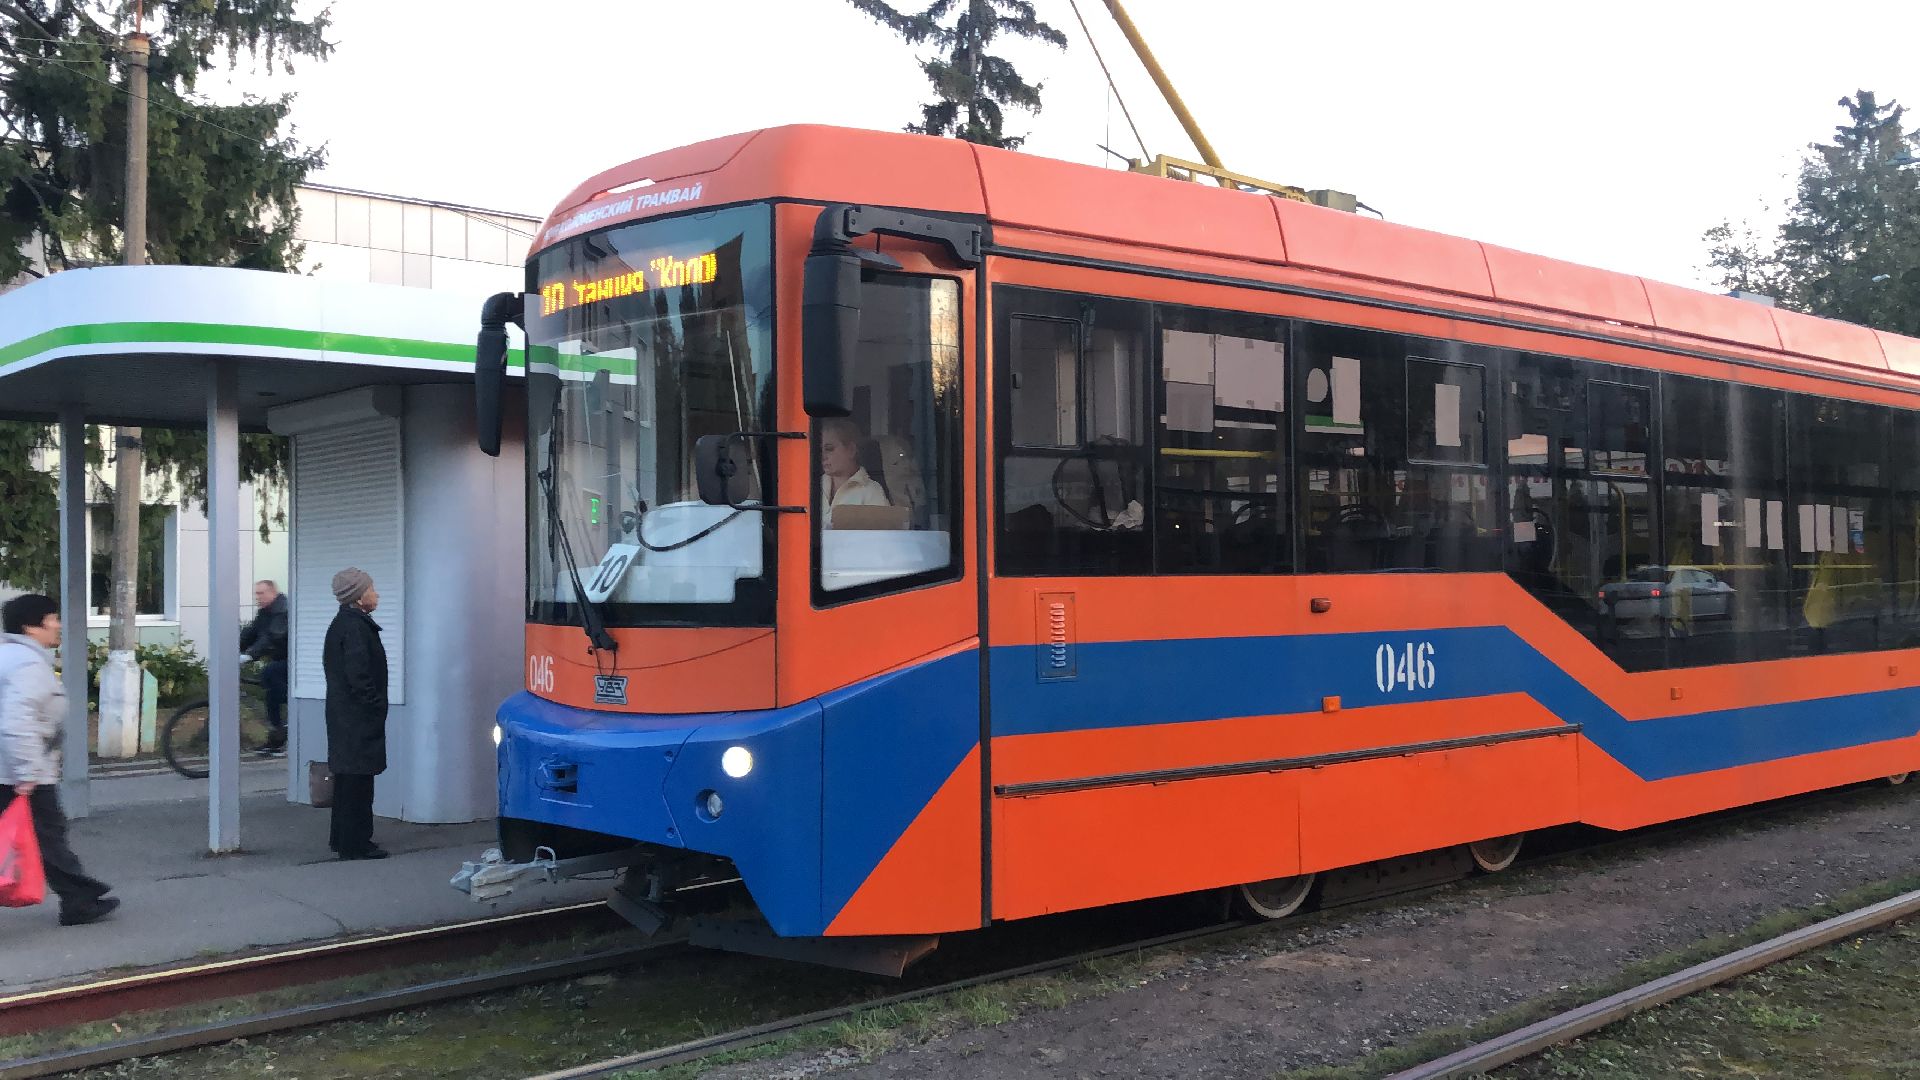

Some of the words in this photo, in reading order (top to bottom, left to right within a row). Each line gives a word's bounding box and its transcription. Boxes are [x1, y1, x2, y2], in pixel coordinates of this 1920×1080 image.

[636, 182, 702, 211] ТРАМВАЙ
[573, 270, 644, 306] танция
[590, 555, 627, 593] 10
[530, 655, 554, 693] 046
[1376, 642, 1435, 692] 046
